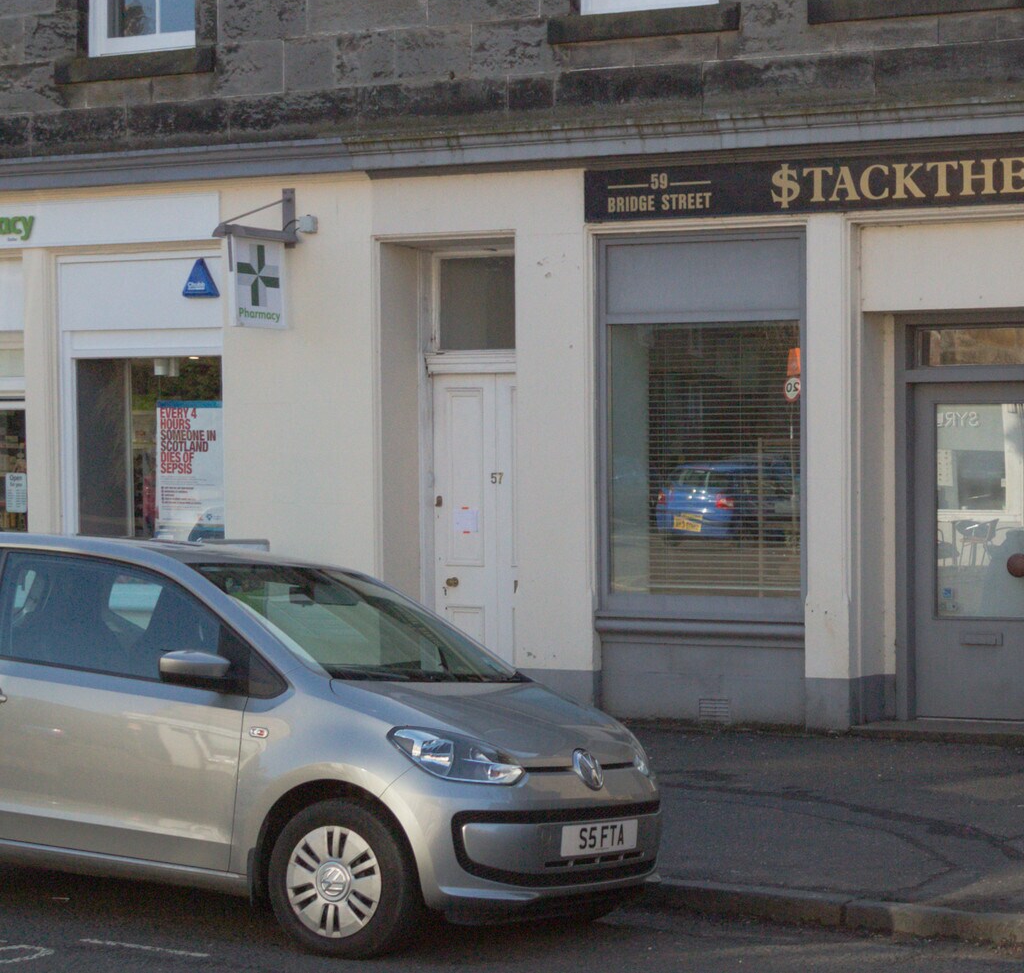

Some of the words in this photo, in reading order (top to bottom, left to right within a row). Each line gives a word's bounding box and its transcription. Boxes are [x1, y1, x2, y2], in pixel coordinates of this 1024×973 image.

[650, 173, 668, 189] 59
[608, 195, 655, 213] BRIDGE
[661, 192, 712, 210] STREET
[239, 307, 281, 323] Pharmacy
[160, 408, 188, 418] EVERY
[191, 408, 197, 419] 4
[160, 419, 191, 429] HOURS
[161, 430, 205, 440] SOMEONE
[207, 430, 216, 441] IN
[161, 441, 209, 452] SCOTLAND
[161, 452, 181, 462] DIES
[183, 452, 194, 462] OF
[161, 463, 192, 474] SEPSIS
[490, 472, 503, 484] 57
[579, 827, 597, 850] S5
[600, 824, 624, 847] FTA
